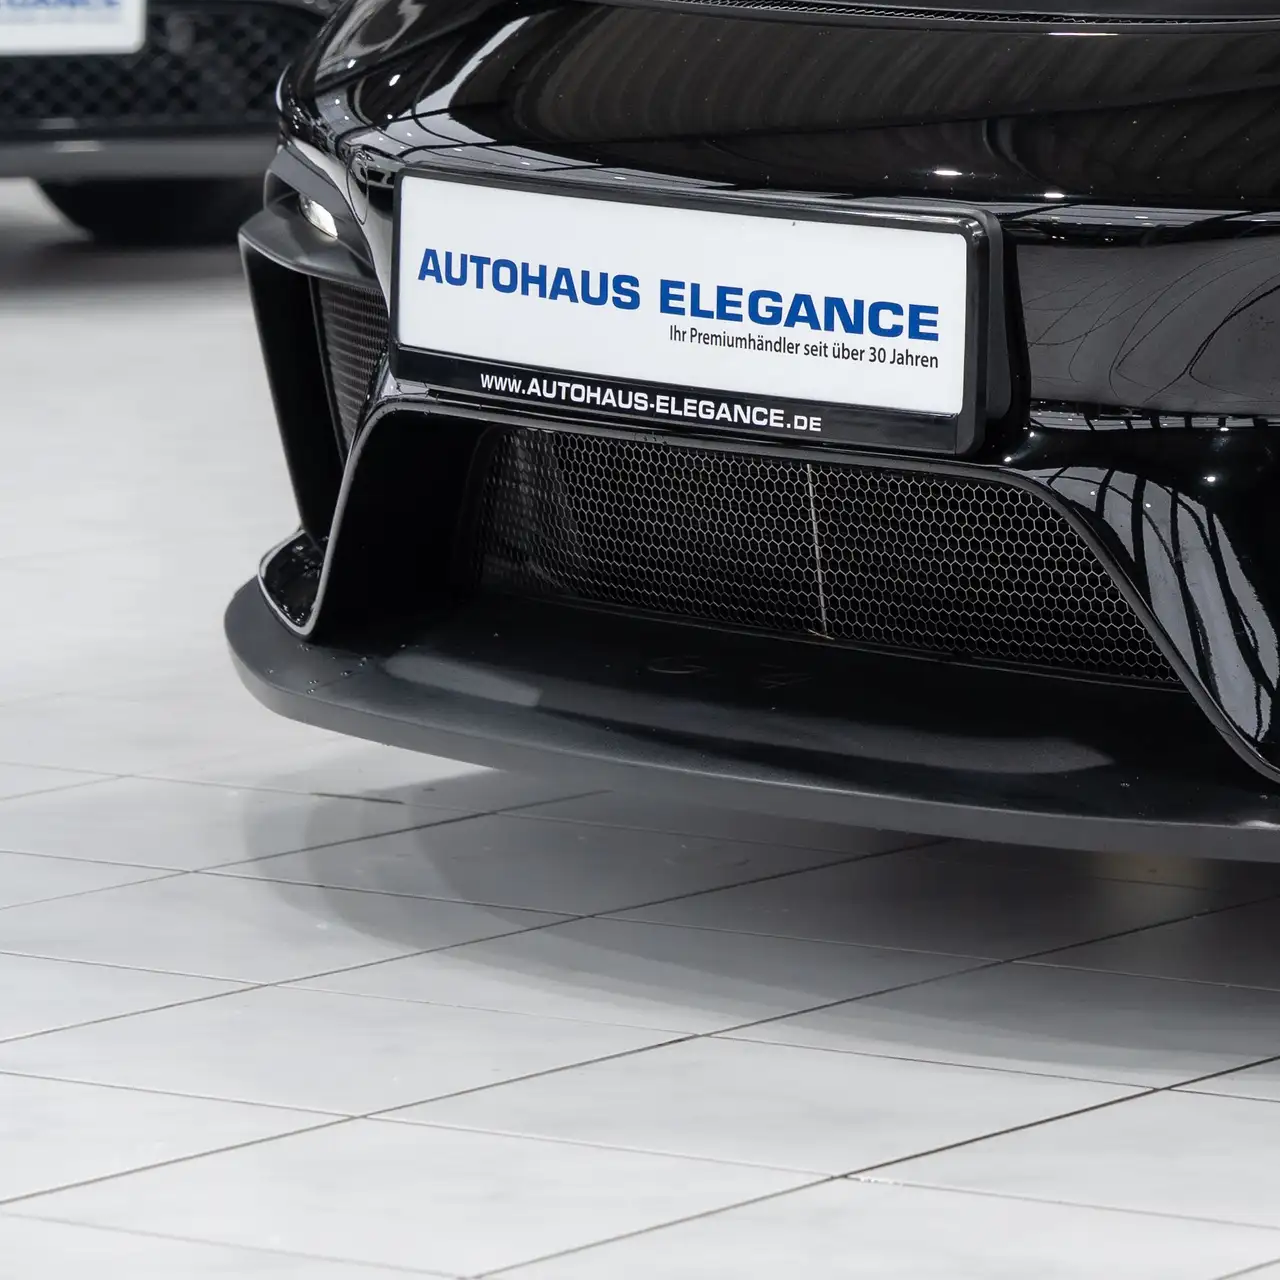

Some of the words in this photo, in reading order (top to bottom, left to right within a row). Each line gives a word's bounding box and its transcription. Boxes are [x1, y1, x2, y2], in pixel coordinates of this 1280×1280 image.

[417, 248, 641, 311] AUTOHAUS
[659, 278, 939, 342] ELEGANCE
[669, 324, 687, 342] Ihr
[690, 327, 801, 355] Premiumhändler
[803, 341, 829, 358] seit
[832, 342, 866, 362] über
[868, 346, 887, 364] 30
[889, 348, 939, 369] Jahren
[480, 373, 822, 432] www.AUTOHAUS-ELEGANCE.DE
